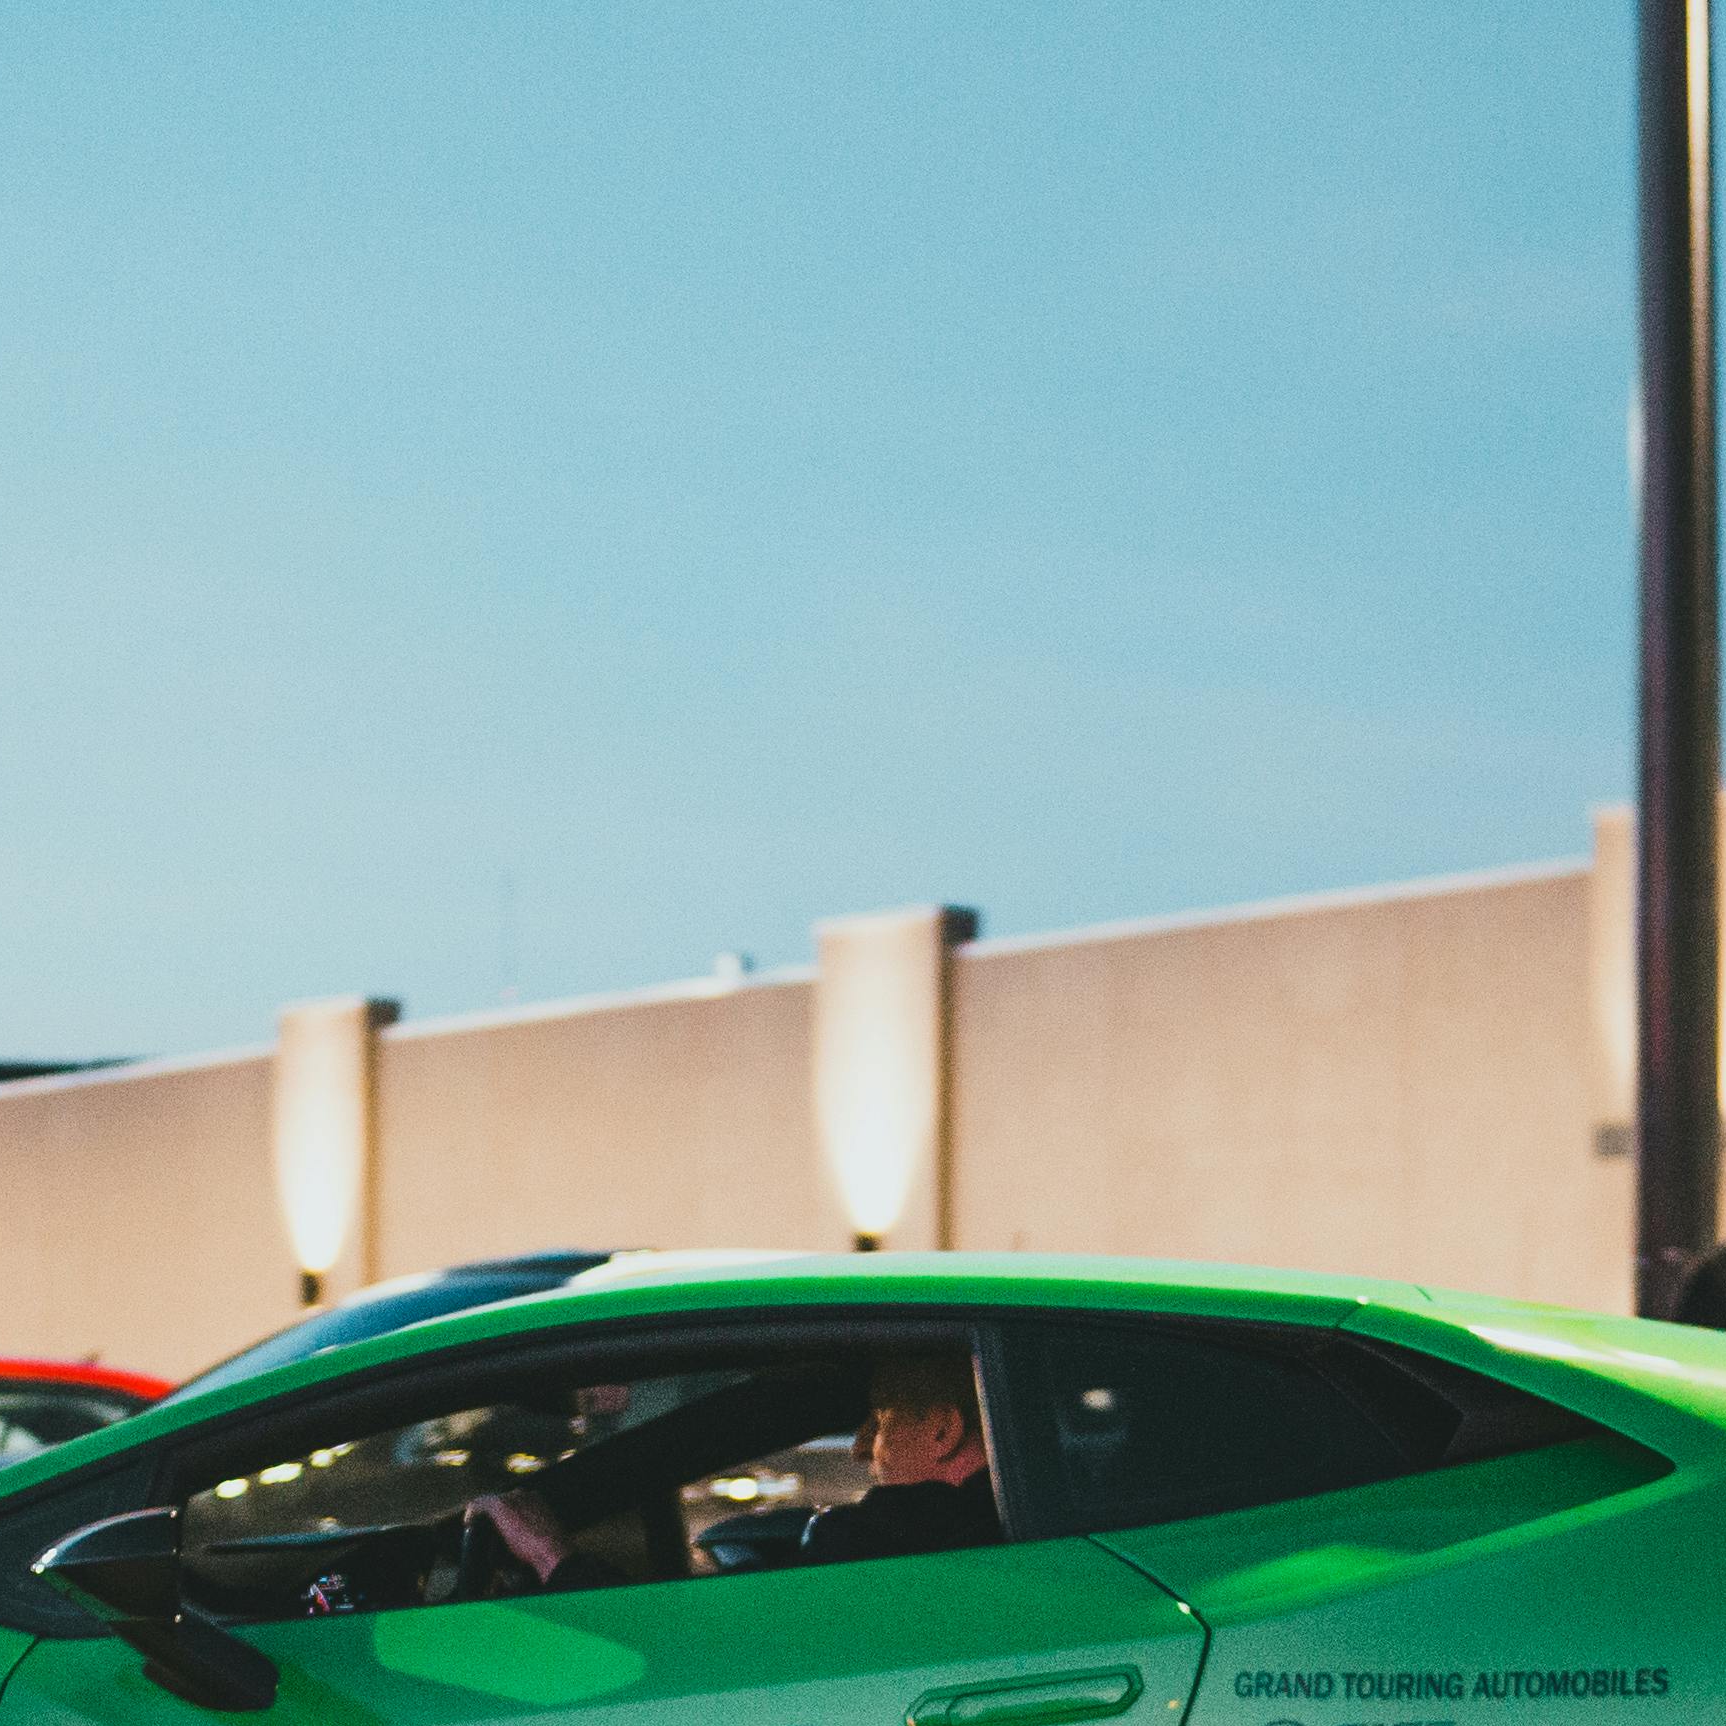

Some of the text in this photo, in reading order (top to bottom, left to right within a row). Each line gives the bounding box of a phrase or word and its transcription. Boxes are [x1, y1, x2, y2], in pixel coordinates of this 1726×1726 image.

[1234, 1667, 1670, 1700] GRAND TOURING AUTOMOBILES
